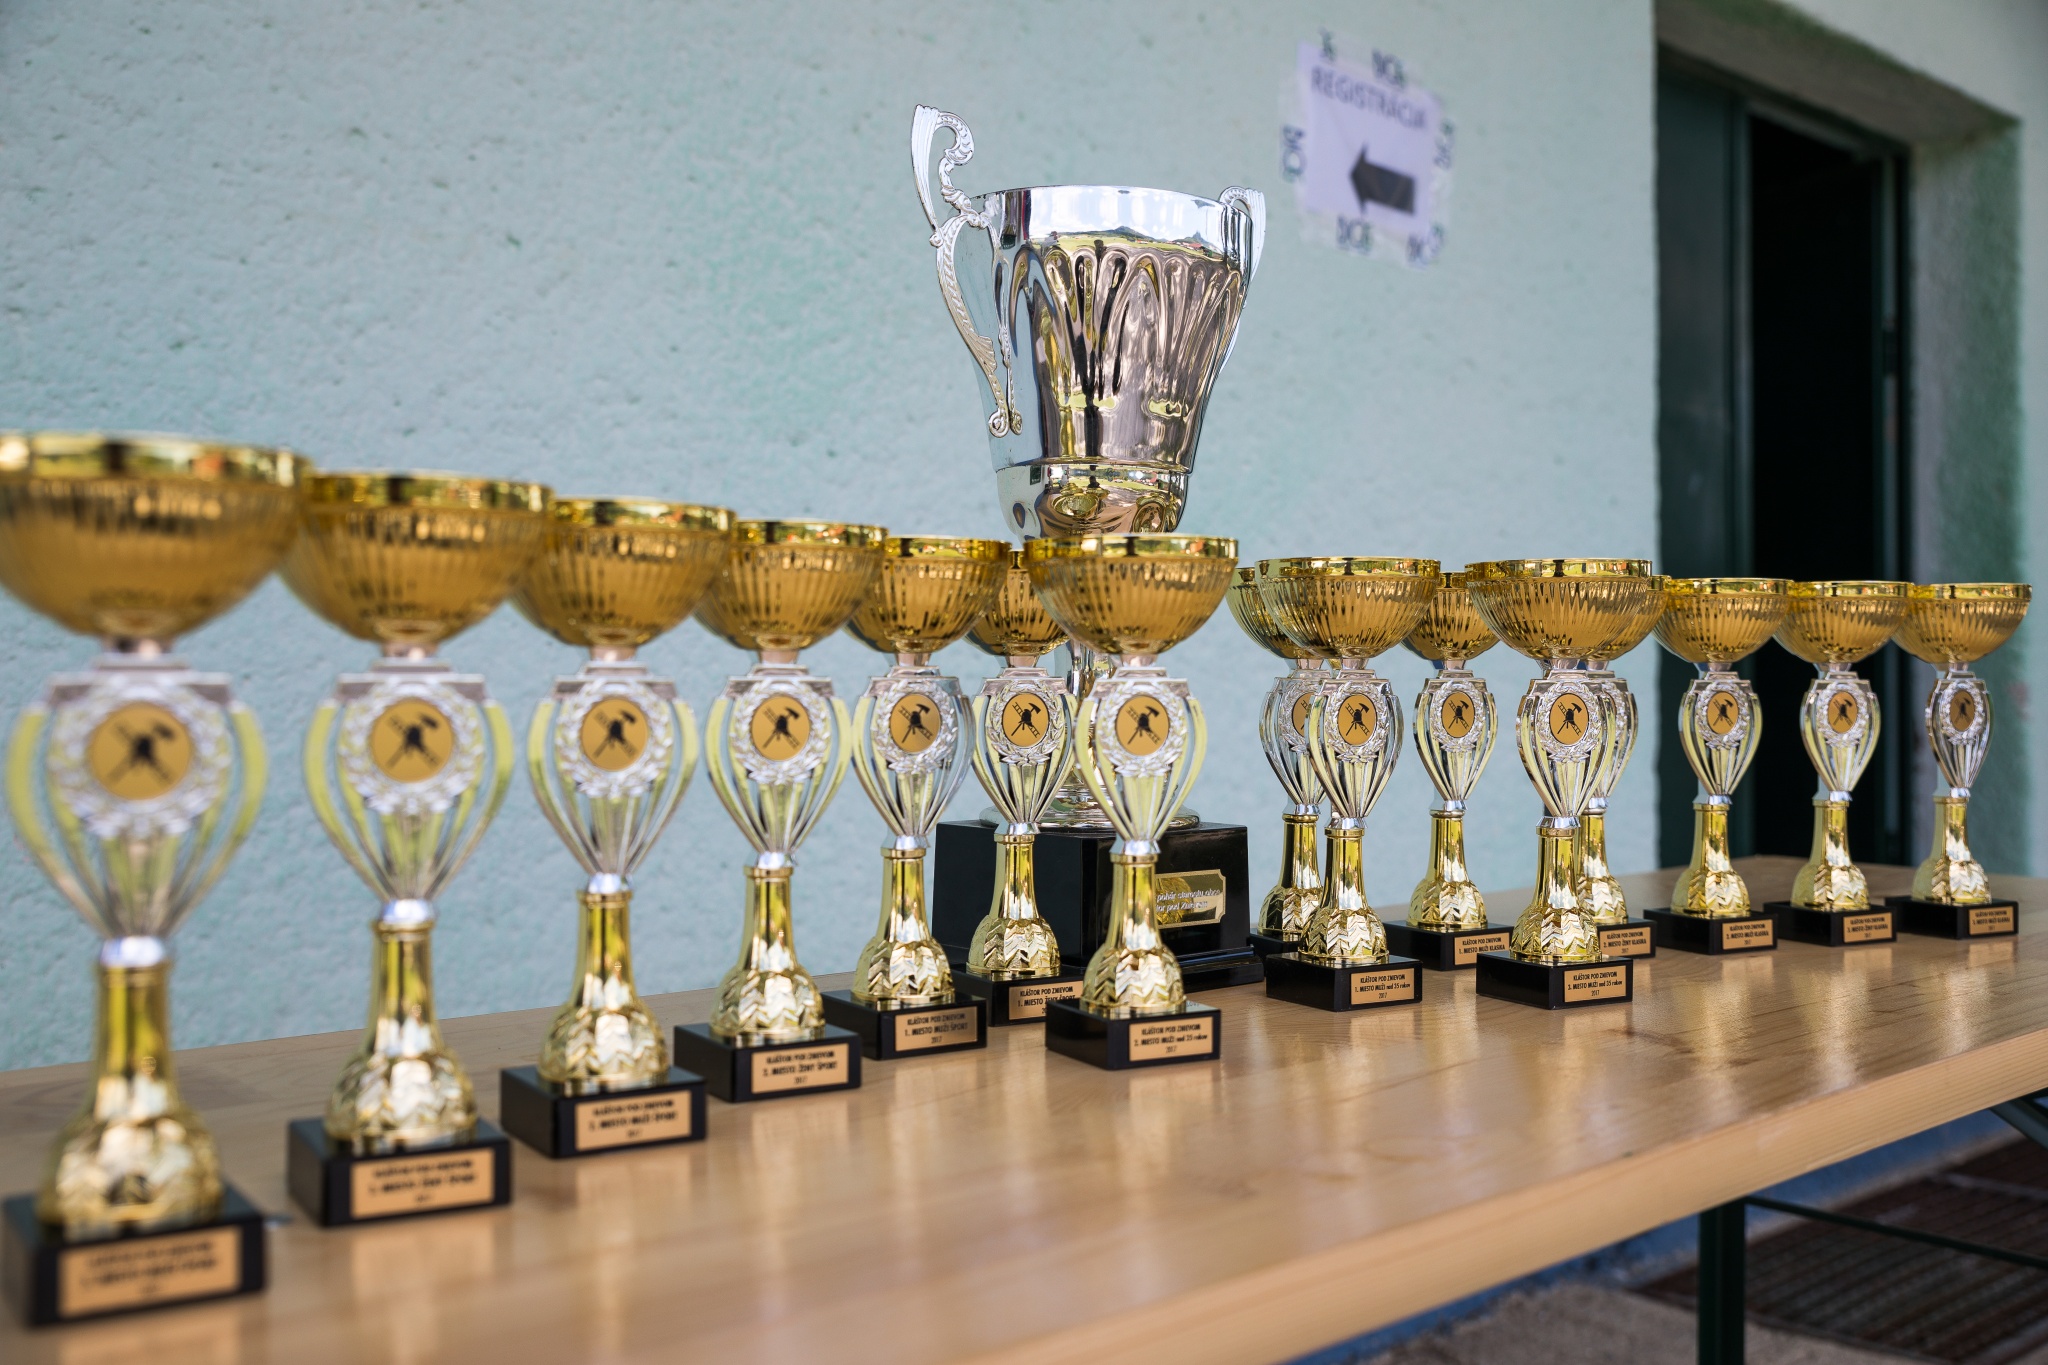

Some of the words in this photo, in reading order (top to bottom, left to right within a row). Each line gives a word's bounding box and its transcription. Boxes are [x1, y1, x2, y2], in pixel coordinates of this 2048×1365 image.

[1020, 989, 1040, 997] KLÁŠTOR
[1024, 998, 1043, 1006] MIESTO
[912, 1027, 932, 1035] MIESTO
